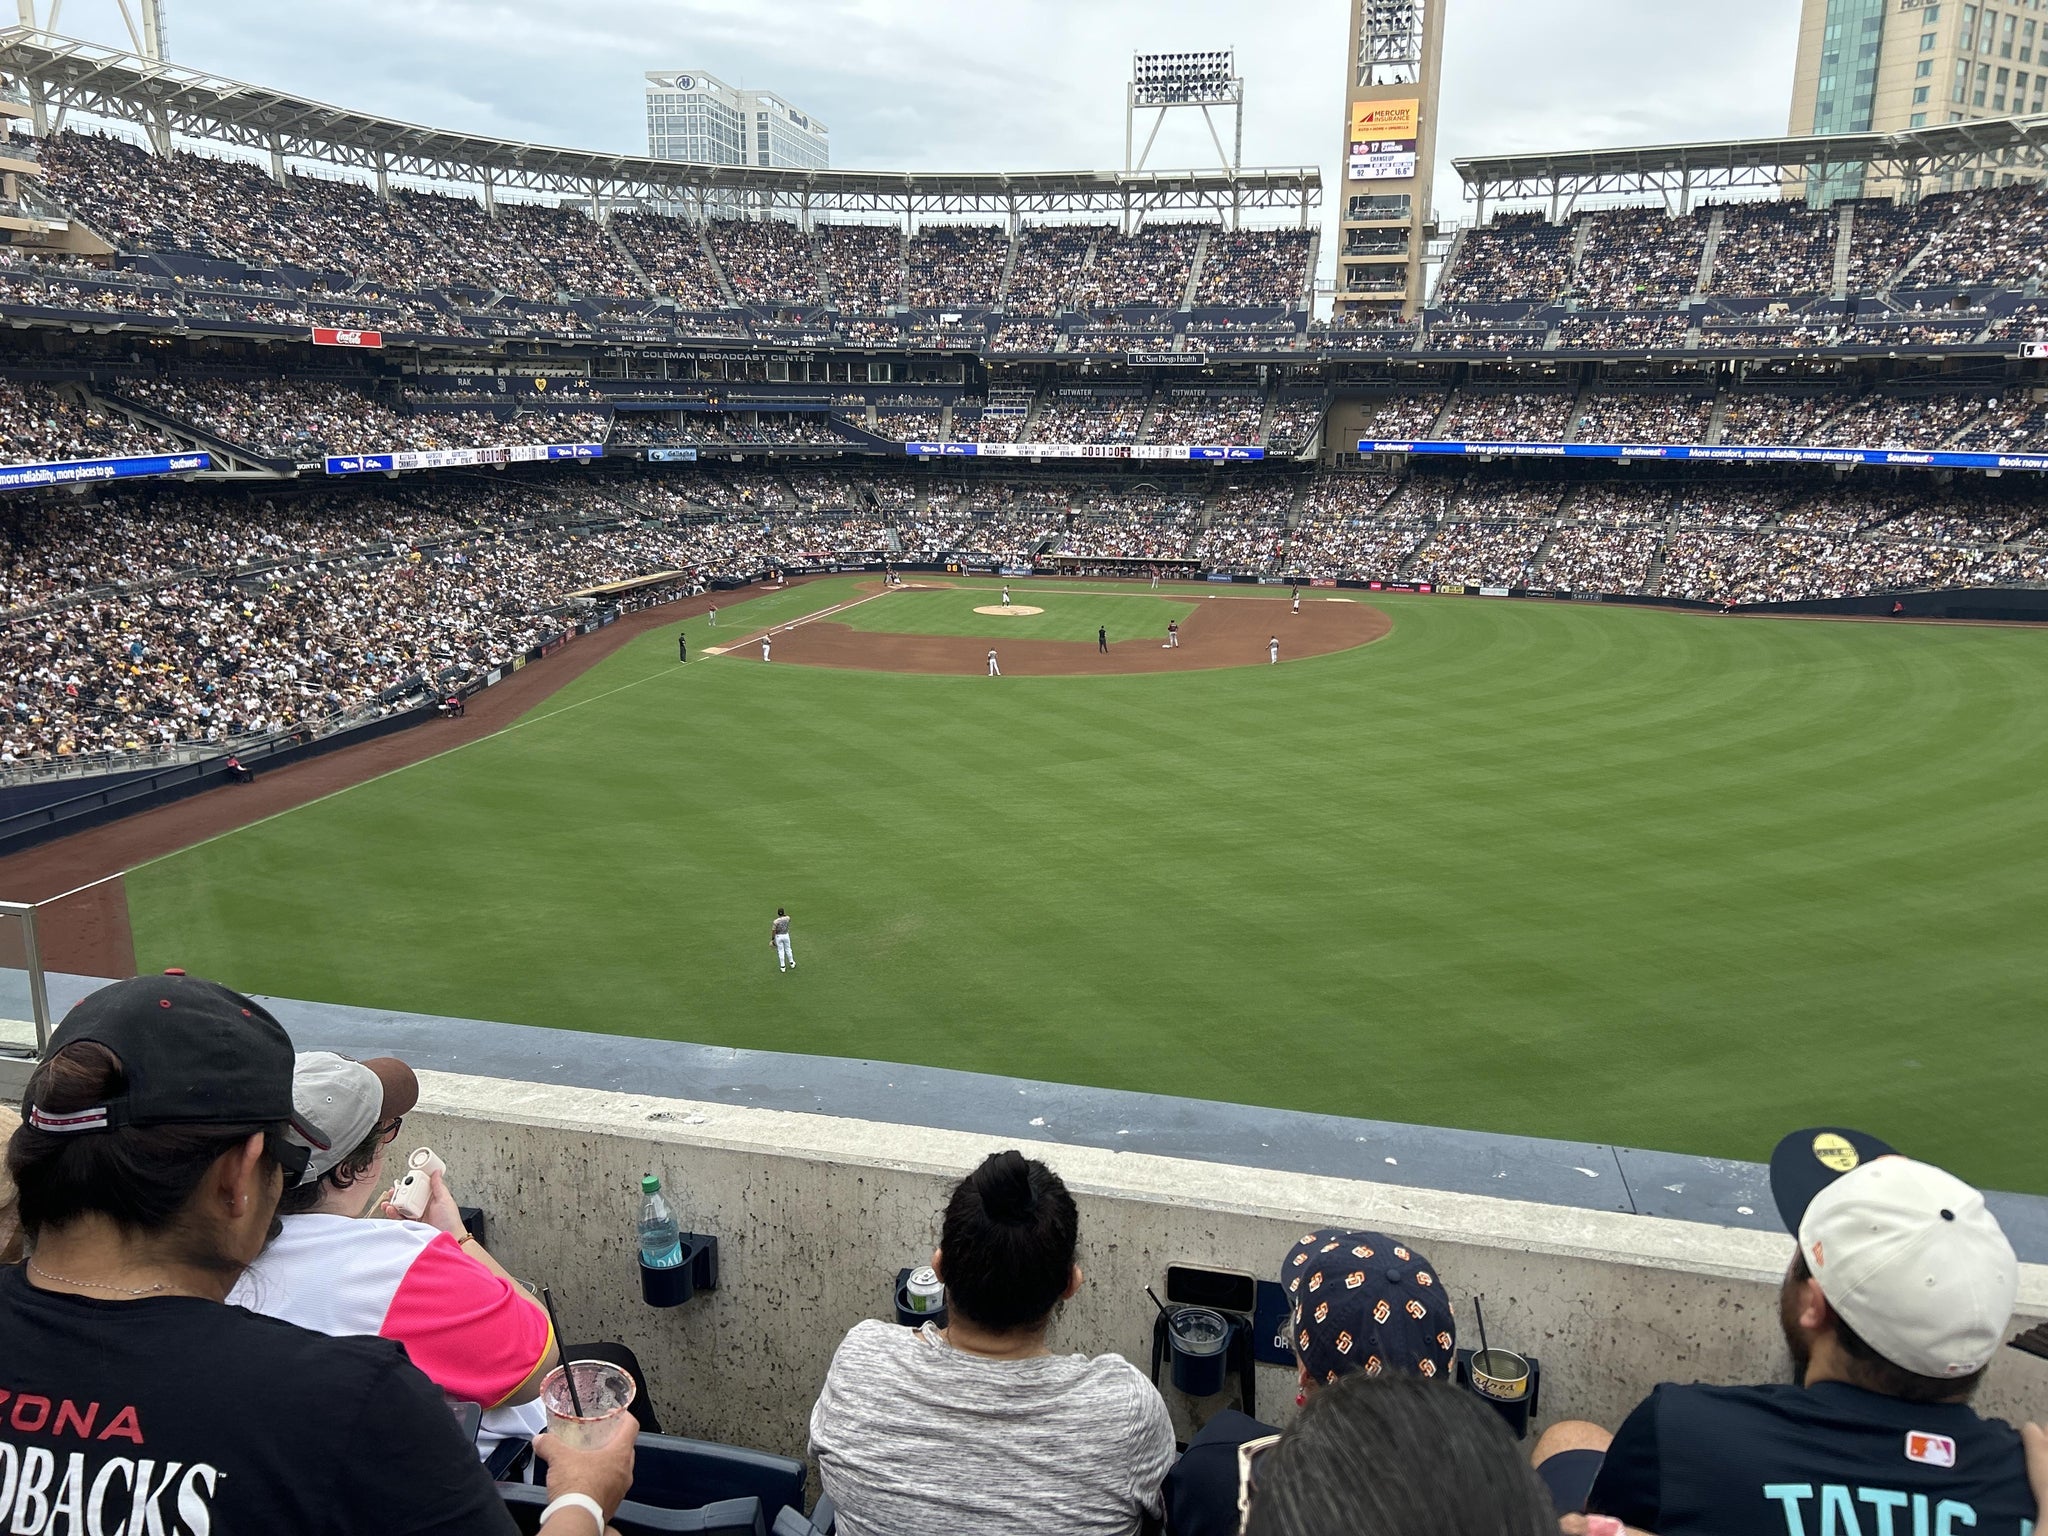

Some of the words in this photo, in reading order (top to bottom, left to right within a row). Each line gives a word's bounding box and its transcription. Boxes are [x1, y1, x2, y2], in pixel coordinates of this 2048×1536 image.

[1371, 142, 1379, 152] 17
[642, 351, 695, 359] COLEMAN
[699, 353, 766, 361] BROADCAST
[1159, 355, 1176, 363] Diego
[1374, 442, 1409, 451] Southwest
[1465, 444, 1487, 453] We've
[1488, 446, 1498, 454] got
[1499, 447, 1514, 455] your
[1516, 446, 1534, 454] bases
[1536, 446, 1565, 454] covered.
[1622, 447, 1662, 456] Southwest
[1711, 449, 1743, 458] comfort,
[1767, 450, 1801, 460] reliability,
[1821, 452, 1844, 461] places
[1853, 454, 1865, 462] go.
[1887, 454, 1928, 463] Southwest
[170, 458, 198, 470] Southwest
[1998, 457, 2020, 467] Book
[0, 475, 19, 484] more
[20, 470, 56, 483] reliability,
[57, 471, 75, 480] more
[75, 468, 97, 480] places
[97, 468, 104, 476] to
[105, 467, 115, 479] go.
